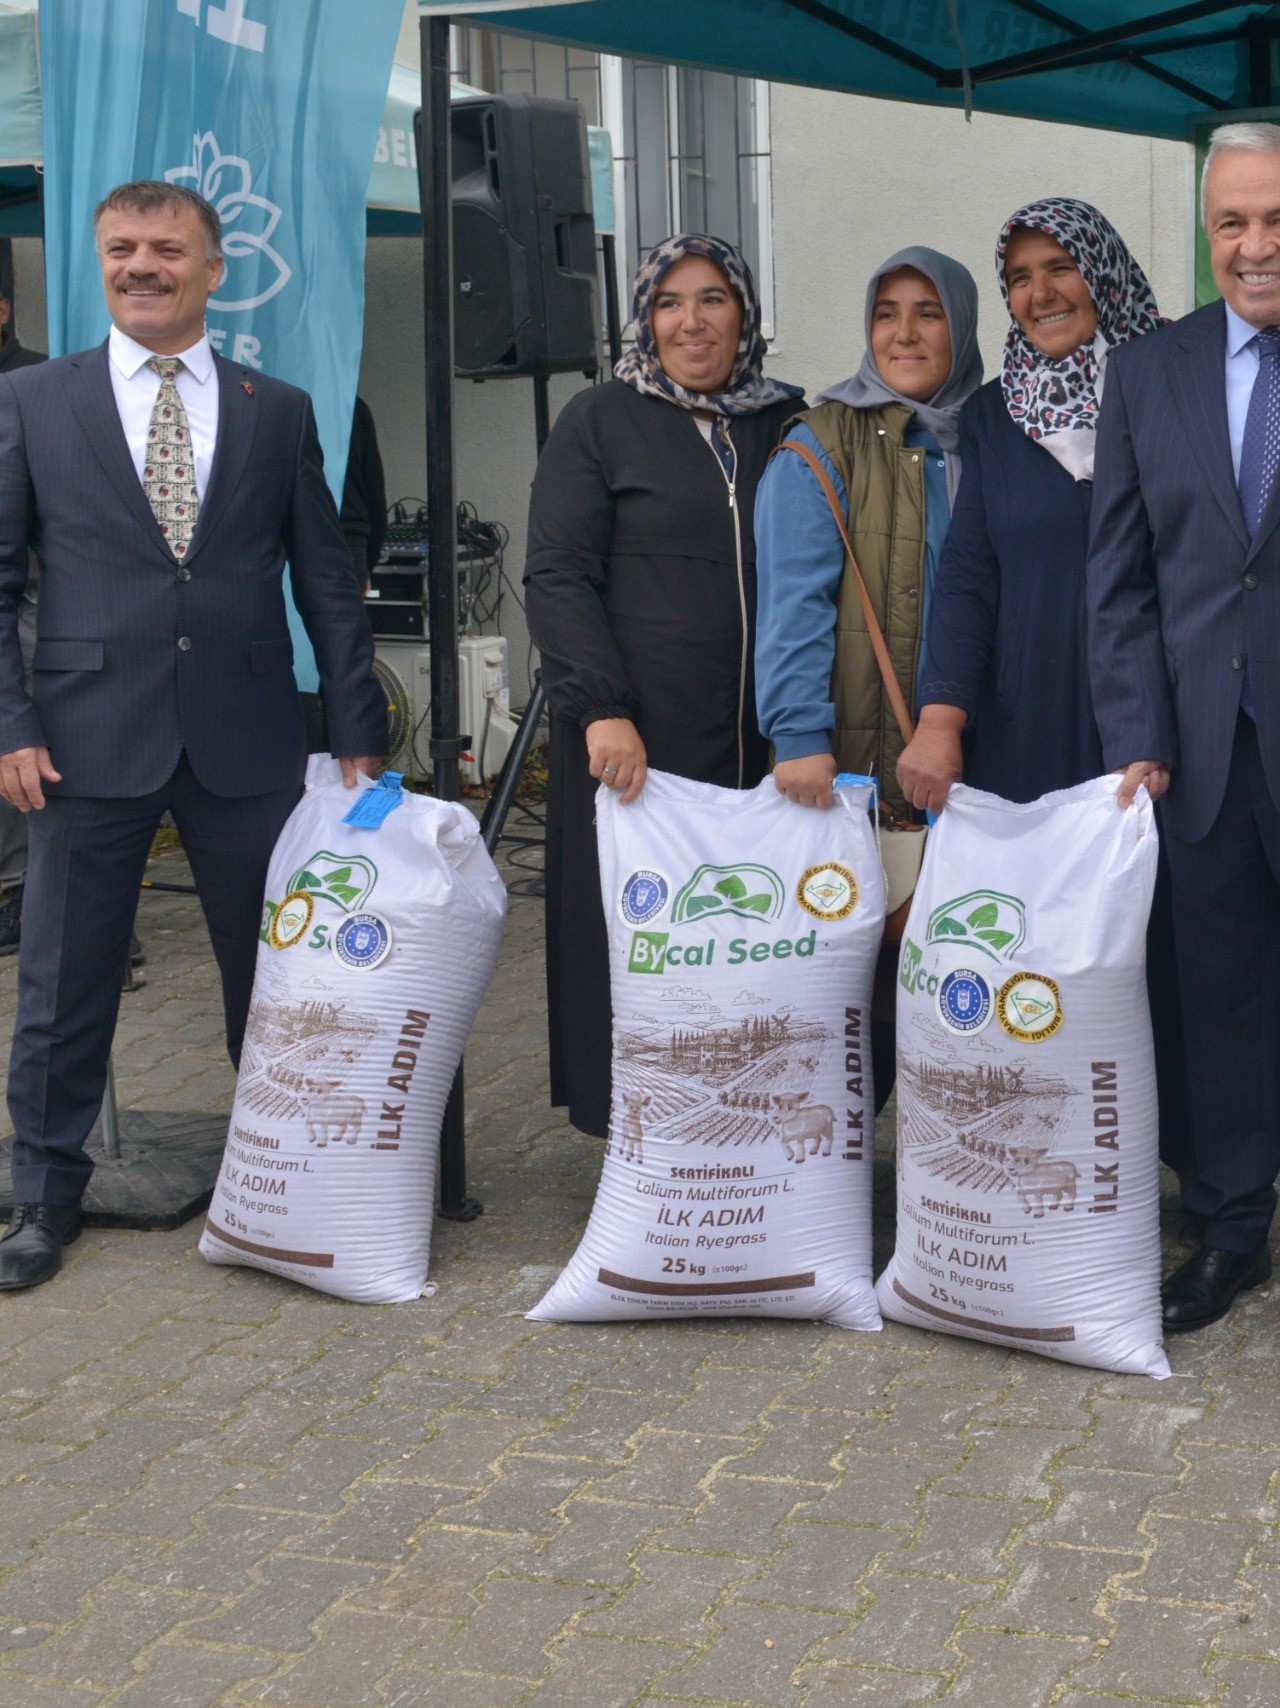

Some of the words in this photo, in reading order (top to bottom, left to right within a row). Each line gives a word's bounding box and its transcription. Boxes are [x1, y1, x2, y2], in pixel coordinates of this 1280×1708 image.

[637, 871, 661, 883] BURSA
[353, 914, 378, 926] BURSA
[632, 937, 716, 971] Bycal
[727, 929, 816, 965] Seed
[902, 945, 940, 996] Byca
[953, 970, 978, 982] BURSA
[964, 998, 989, 1030] BELEDİYESİ
[387, 1009, 431, 1094] ADIM
[844, 1007, 863, 1097] ADIM
[1091, 1062, 1120, 1151] ADIM
[370, 1101, 405, 1151] İLK
[842, 1108, 864, 1160] İLK
[237, 1148, 299, 1172] Multiforum
[303, 1159, 314, 1173] L.
[670, 1163, 755, 1180] SERTİFİKALI
[240, 1173, 286, 1196] ADIM
[635, 1179, 682, 1200] Lolium
[686, 1184, 778, 1201] Multiforum
[783, 1178, 794, 1193] L.
[1088, 1162, 1120, 1213] İLK
[240, 1195, 288, 1216] Ryegrass
[657, 1203, 693, 1227] İLK
[698, 1205, 765, 1227] ADIM
[920, 1195, 992, 1224] SERTİFİKALI
[225, 1209, 236, 1227] 25
[238, 1220, 247, 1234] kg
[902, 1197, 931, 1230] Lolium
[934, 1220, 1018, 1246] Multiforum
[1023, 1231, 1035, 1245] L.
[645, 1231, 689, 1248] Italian
[696, 1232, 767, 1250] Ryegrass
[917, 1229, 942, 1260] İLK
[947, 1247, 1008, 1272] ADIM
[661, 1257, 686, 1273] 25
[690, 1263, 706, 1275] kg
[913, 1252, 945, 1279] Italian
[949, 1270, 1014, 1293] Ryegrass
[929, 1283, 949, 1303] 25
[951, 1295, 966, 1310] kg
